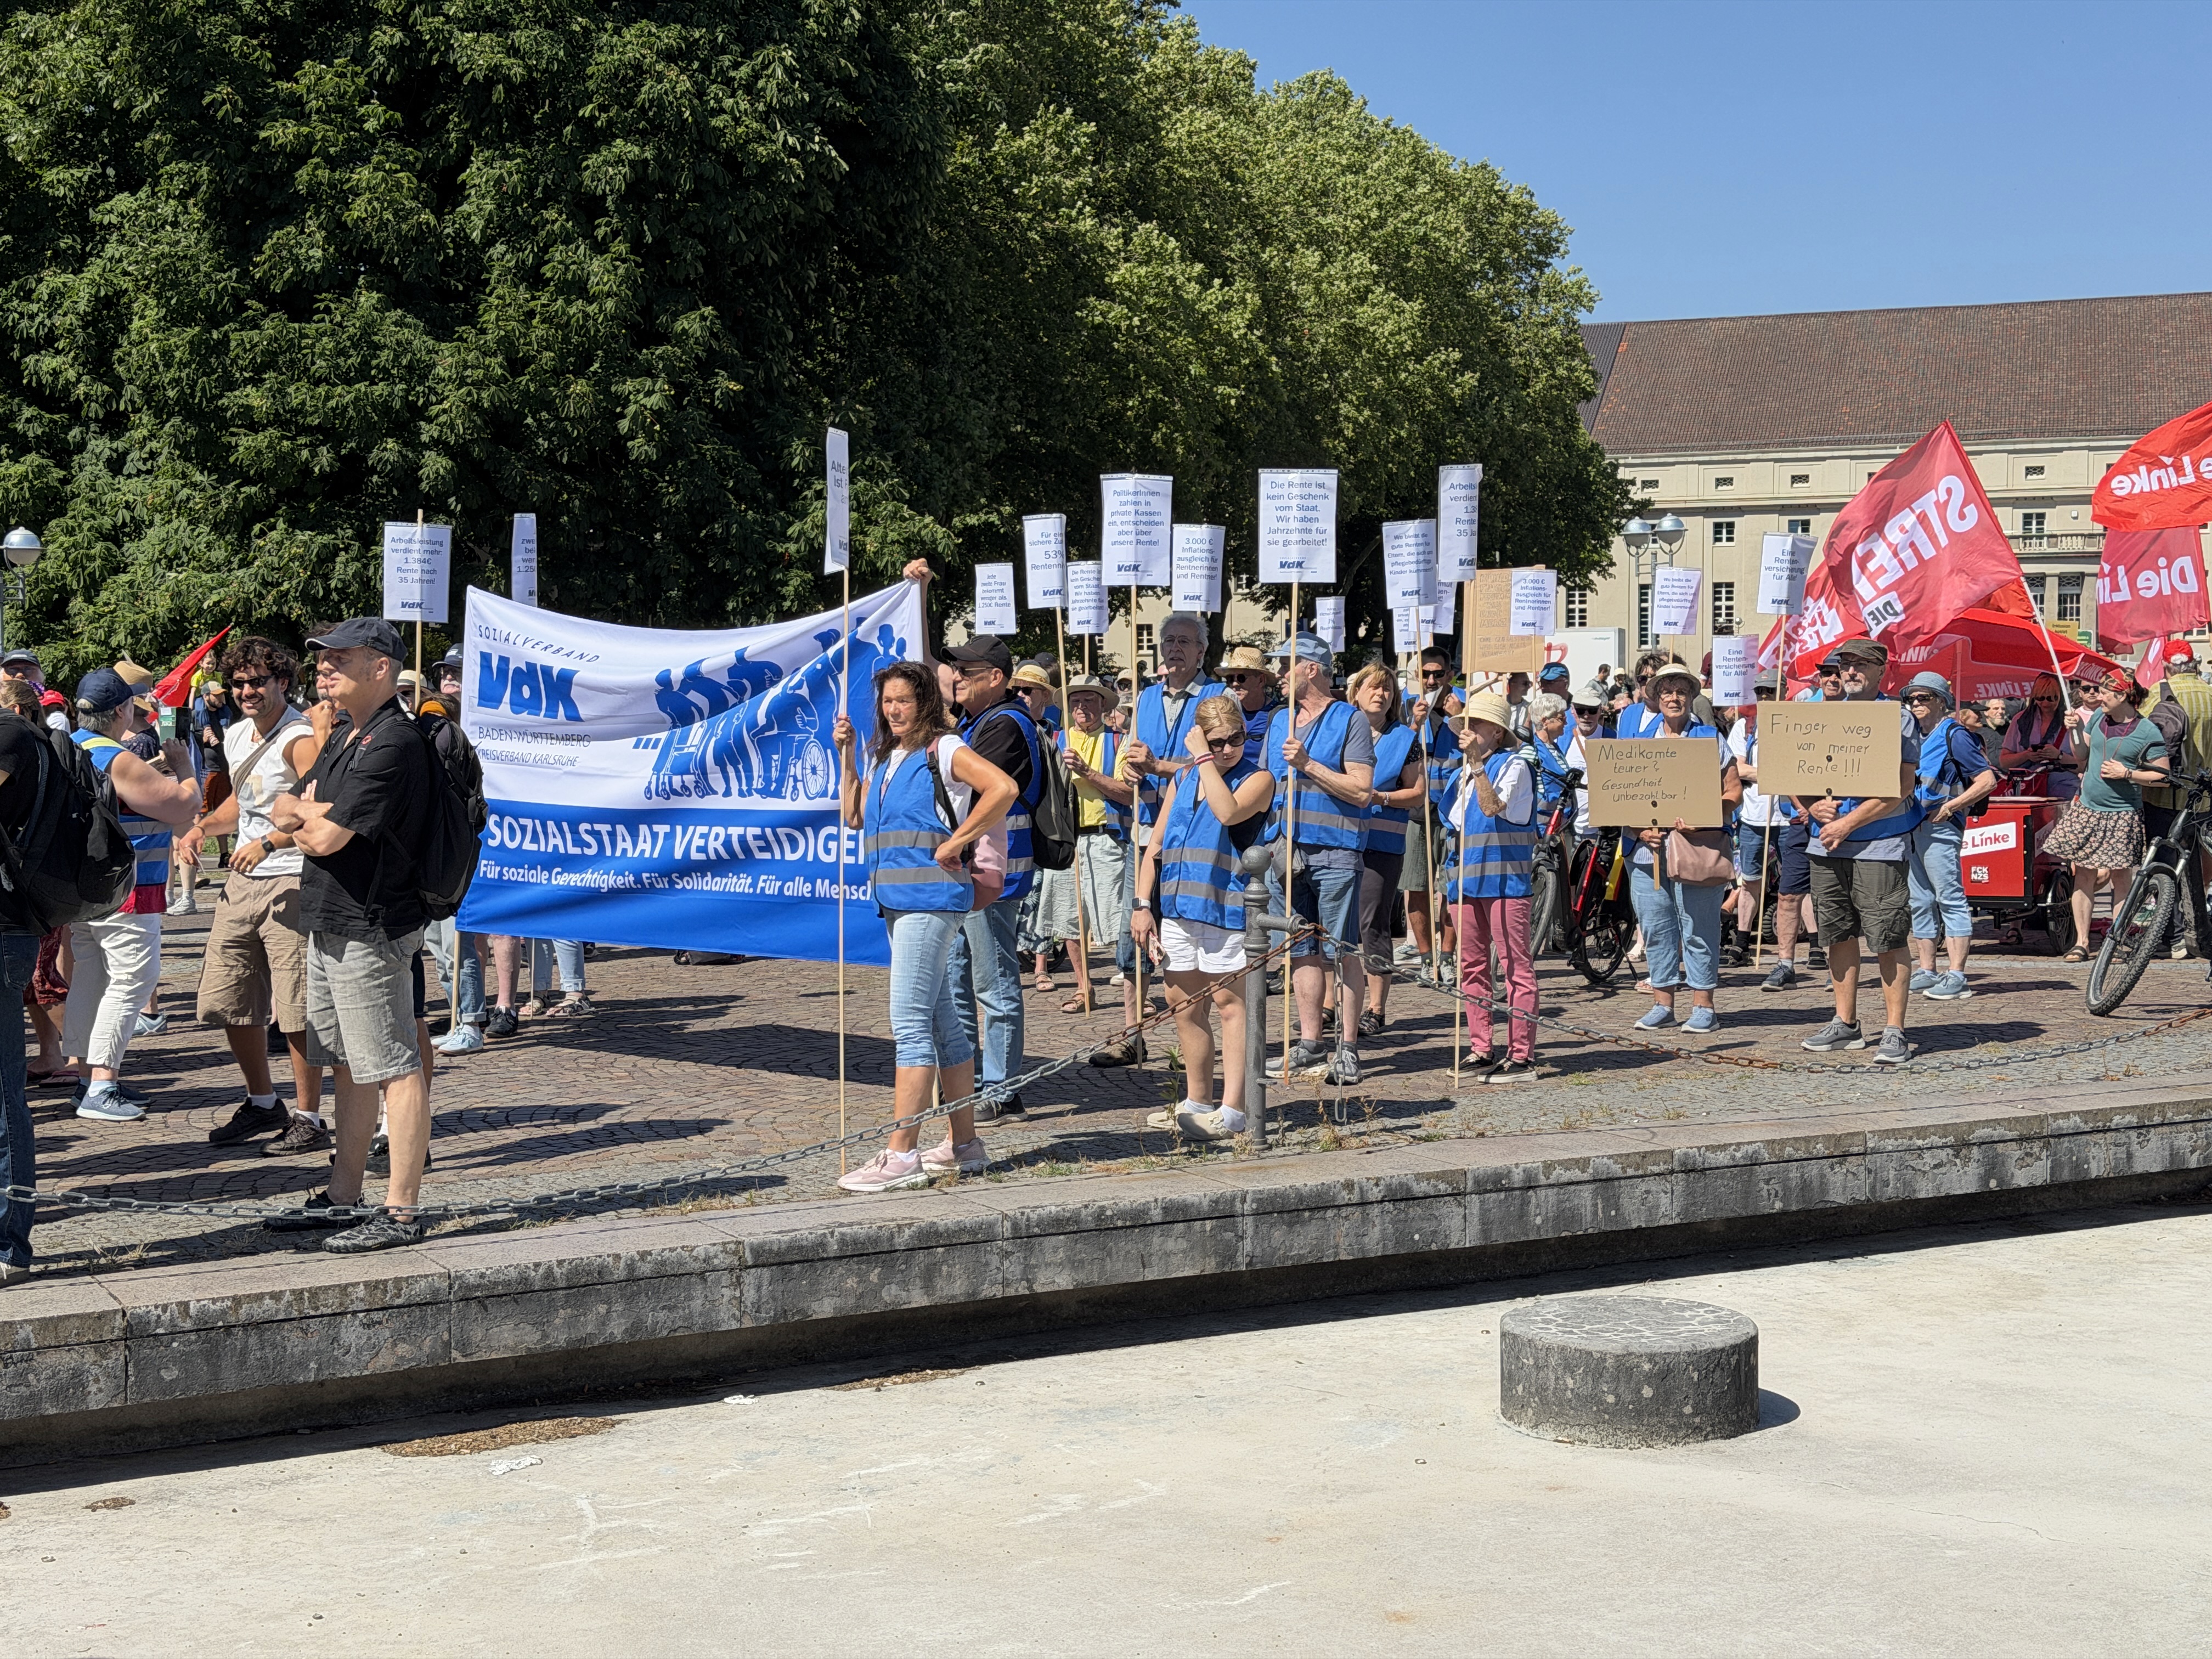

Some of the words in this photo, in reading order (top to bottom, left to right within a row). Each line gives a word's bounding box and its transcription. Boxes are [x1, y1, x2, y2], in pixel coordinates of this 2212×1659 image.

[1296, 504, 1321, 512] Staat.
[1316, 526, 1328, 534] für
[391, 537, 443, 547] Arbeitsleistung
[1267, 538, 1279, 546] sie
[1283, 538, 1327, 548] gearbeitet!
[1177, 555, 1209, 563] ausgleich
[1279, 561, 1305, 569] VdK
[1117, 564, 1142, 572] VdK
[478, 624, 601, 663] SOZIALVERBAND
[477, 651, 585, 722] VdK
[1771, 714, 1828, 735] Finger
[1842, 725, 1871, 738] weg
[478, 726, 591, 747] BADEN-WÜRTTEMBERG
[1797, 742, 1815, 751] von
[1829, 743, 1870, 754] meiner
[477, 748, 532, 763] KREISVERBAND
[532, 753, 579, 766] KARLSRUHE
[1602, 777, 1662, 790] Gesundheit
[488, 814, 670, 858] SOZIALSTAAT
[1972, 832, 2010, 848] Linke
[479, 860, 500, 879] Für
[503, 864, 549, 884] soziale
[551, 867, 641, 893] Gerechtigkeit.
[642, 872, 669, 889] Für
[672, 872, 753, 894] Solidarität.
[757, 875, 782, 895] Für
[784, 877, 811, 897] alle
